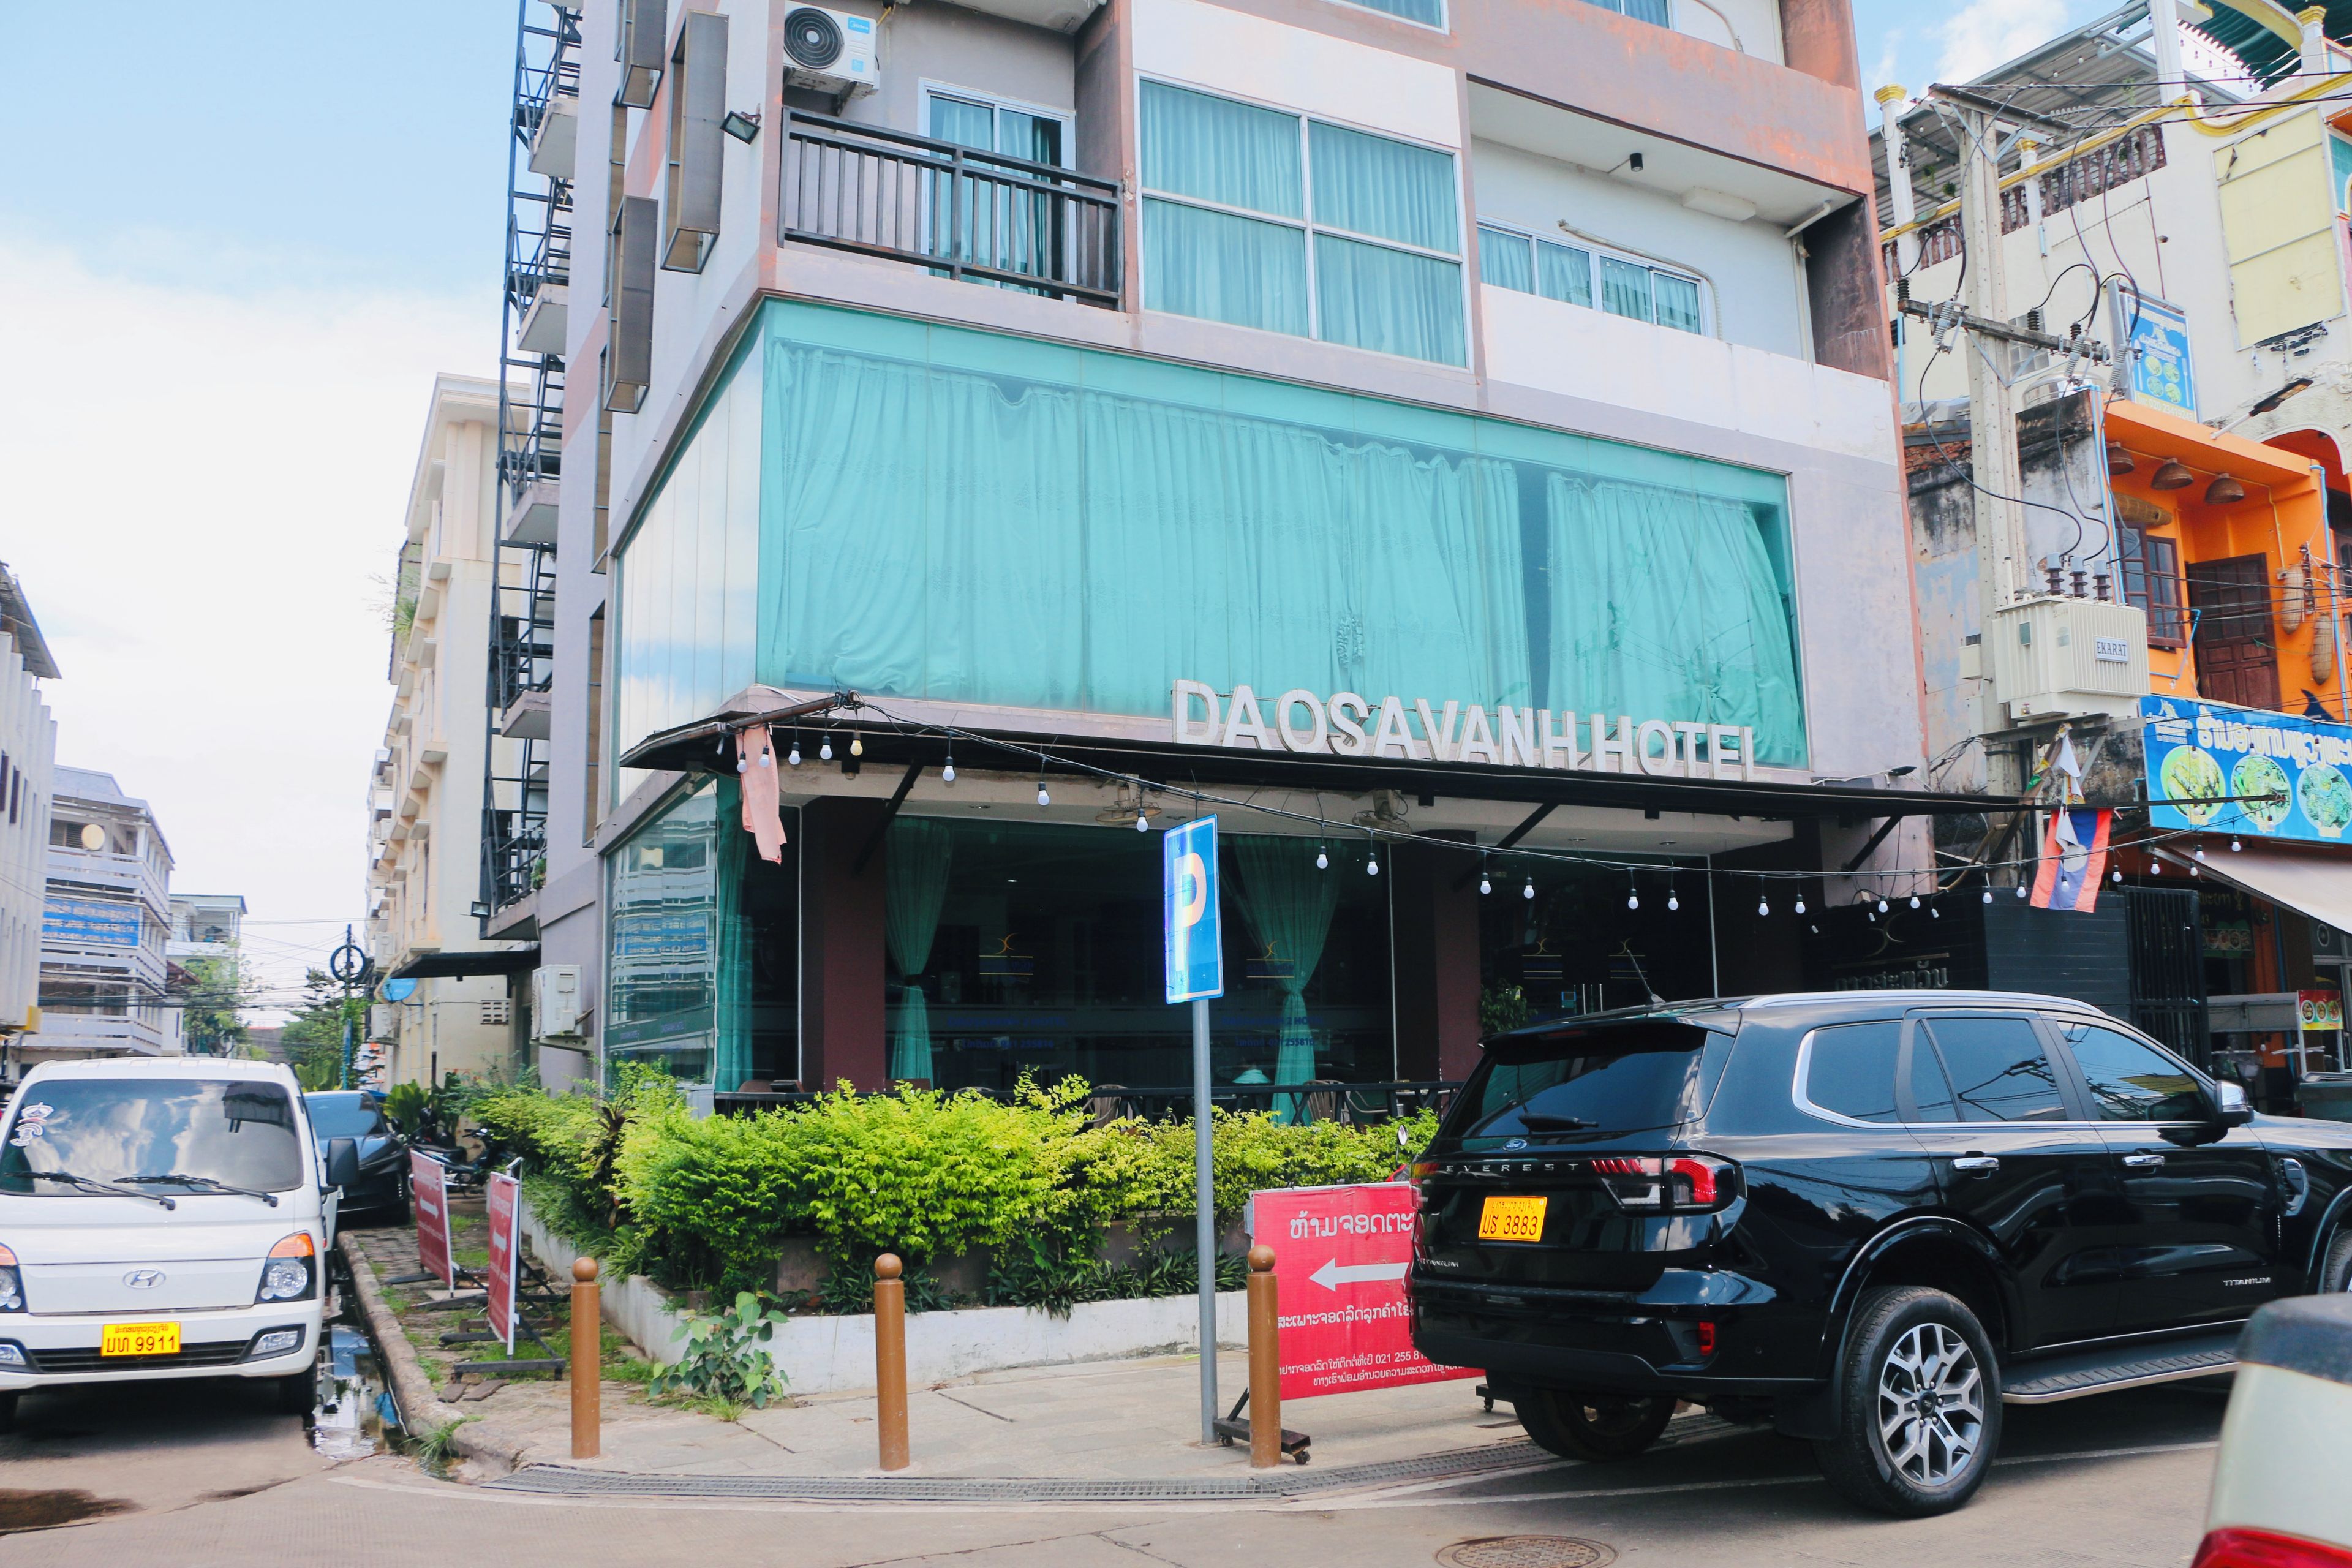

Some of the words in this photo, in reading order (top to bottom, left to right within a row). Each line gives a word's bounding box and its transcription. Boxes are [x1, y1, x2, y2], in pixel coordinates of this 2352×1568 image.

[2097, 641, 2127, 657] EKARAT
[1172, 679, 1578, 771] DAOSAVANH
[1590, 714, 1755, 782] HOTEL
[1173, 852, 1207, 972] P
[1446, 1163, 1578, 1172] EVEREST
[1290, 1210, 1415, 1239] ຫ້າມຈອດຕະ
[1503, 1215, 1538, 1236] 3883
[2223, 1276, 2271, 1287] TITANIUM
[135, 1335, 175, 1352] 9911
[1375, 1353, 1391, 1365] 021
[1394, 1351, 1411, 1363] 255
[1413, 1350, 1427, 1360] 81
